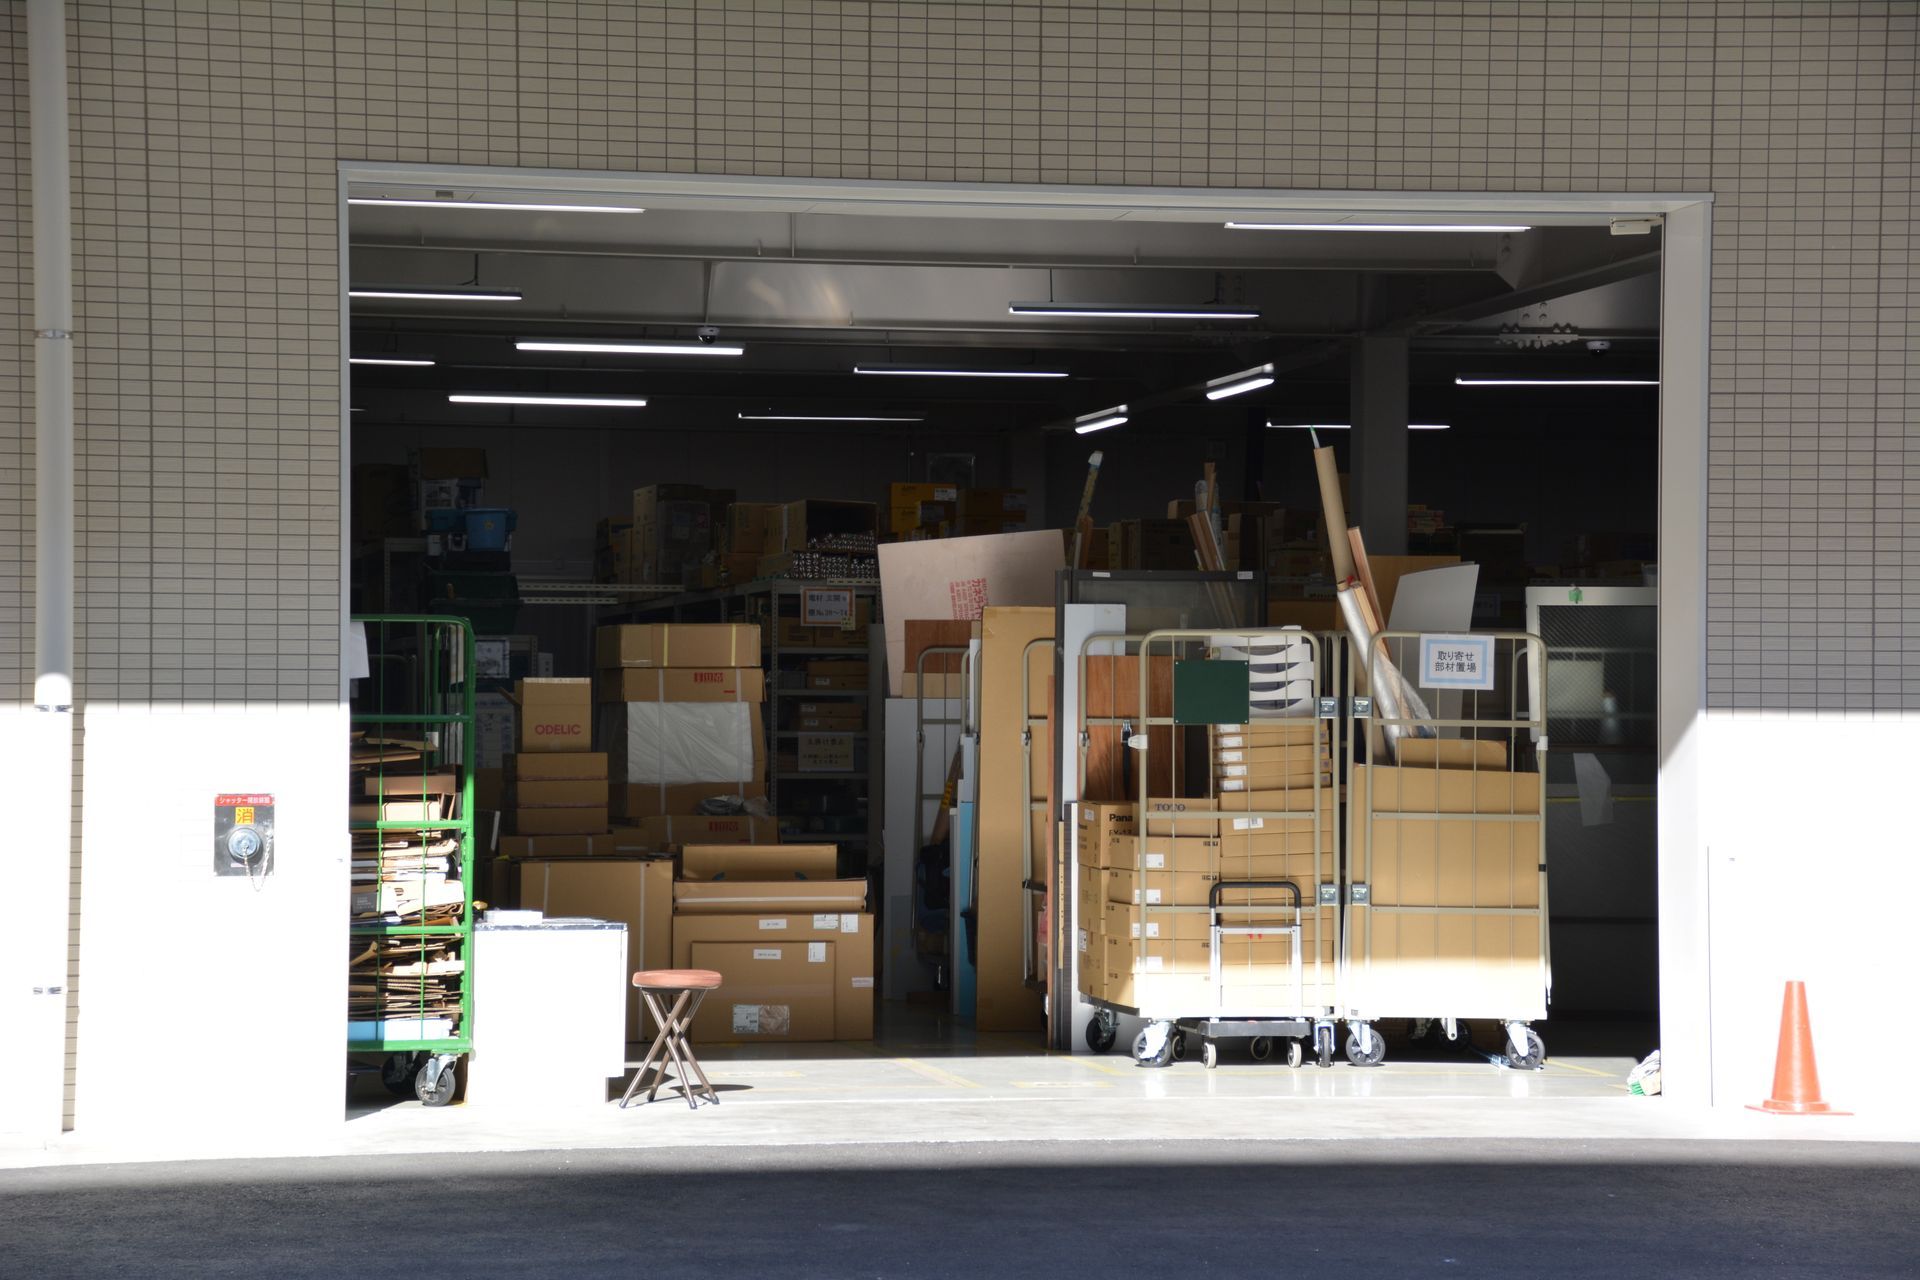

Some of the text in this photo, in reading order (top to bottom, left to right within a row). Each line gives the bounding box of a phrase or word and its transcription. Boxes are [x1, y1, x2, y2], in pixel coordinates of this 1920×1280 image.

[1438, 650, 1475, 661] 取り寄せ
[1435, 662, 1477, 673] 部材置場
[534, 724, 581, 736] ODELIC
[1155, 803, 1186, 812] TOTO
[236, 808, 253, 824] 消
[1109, 813, 1133, 822] Pana
